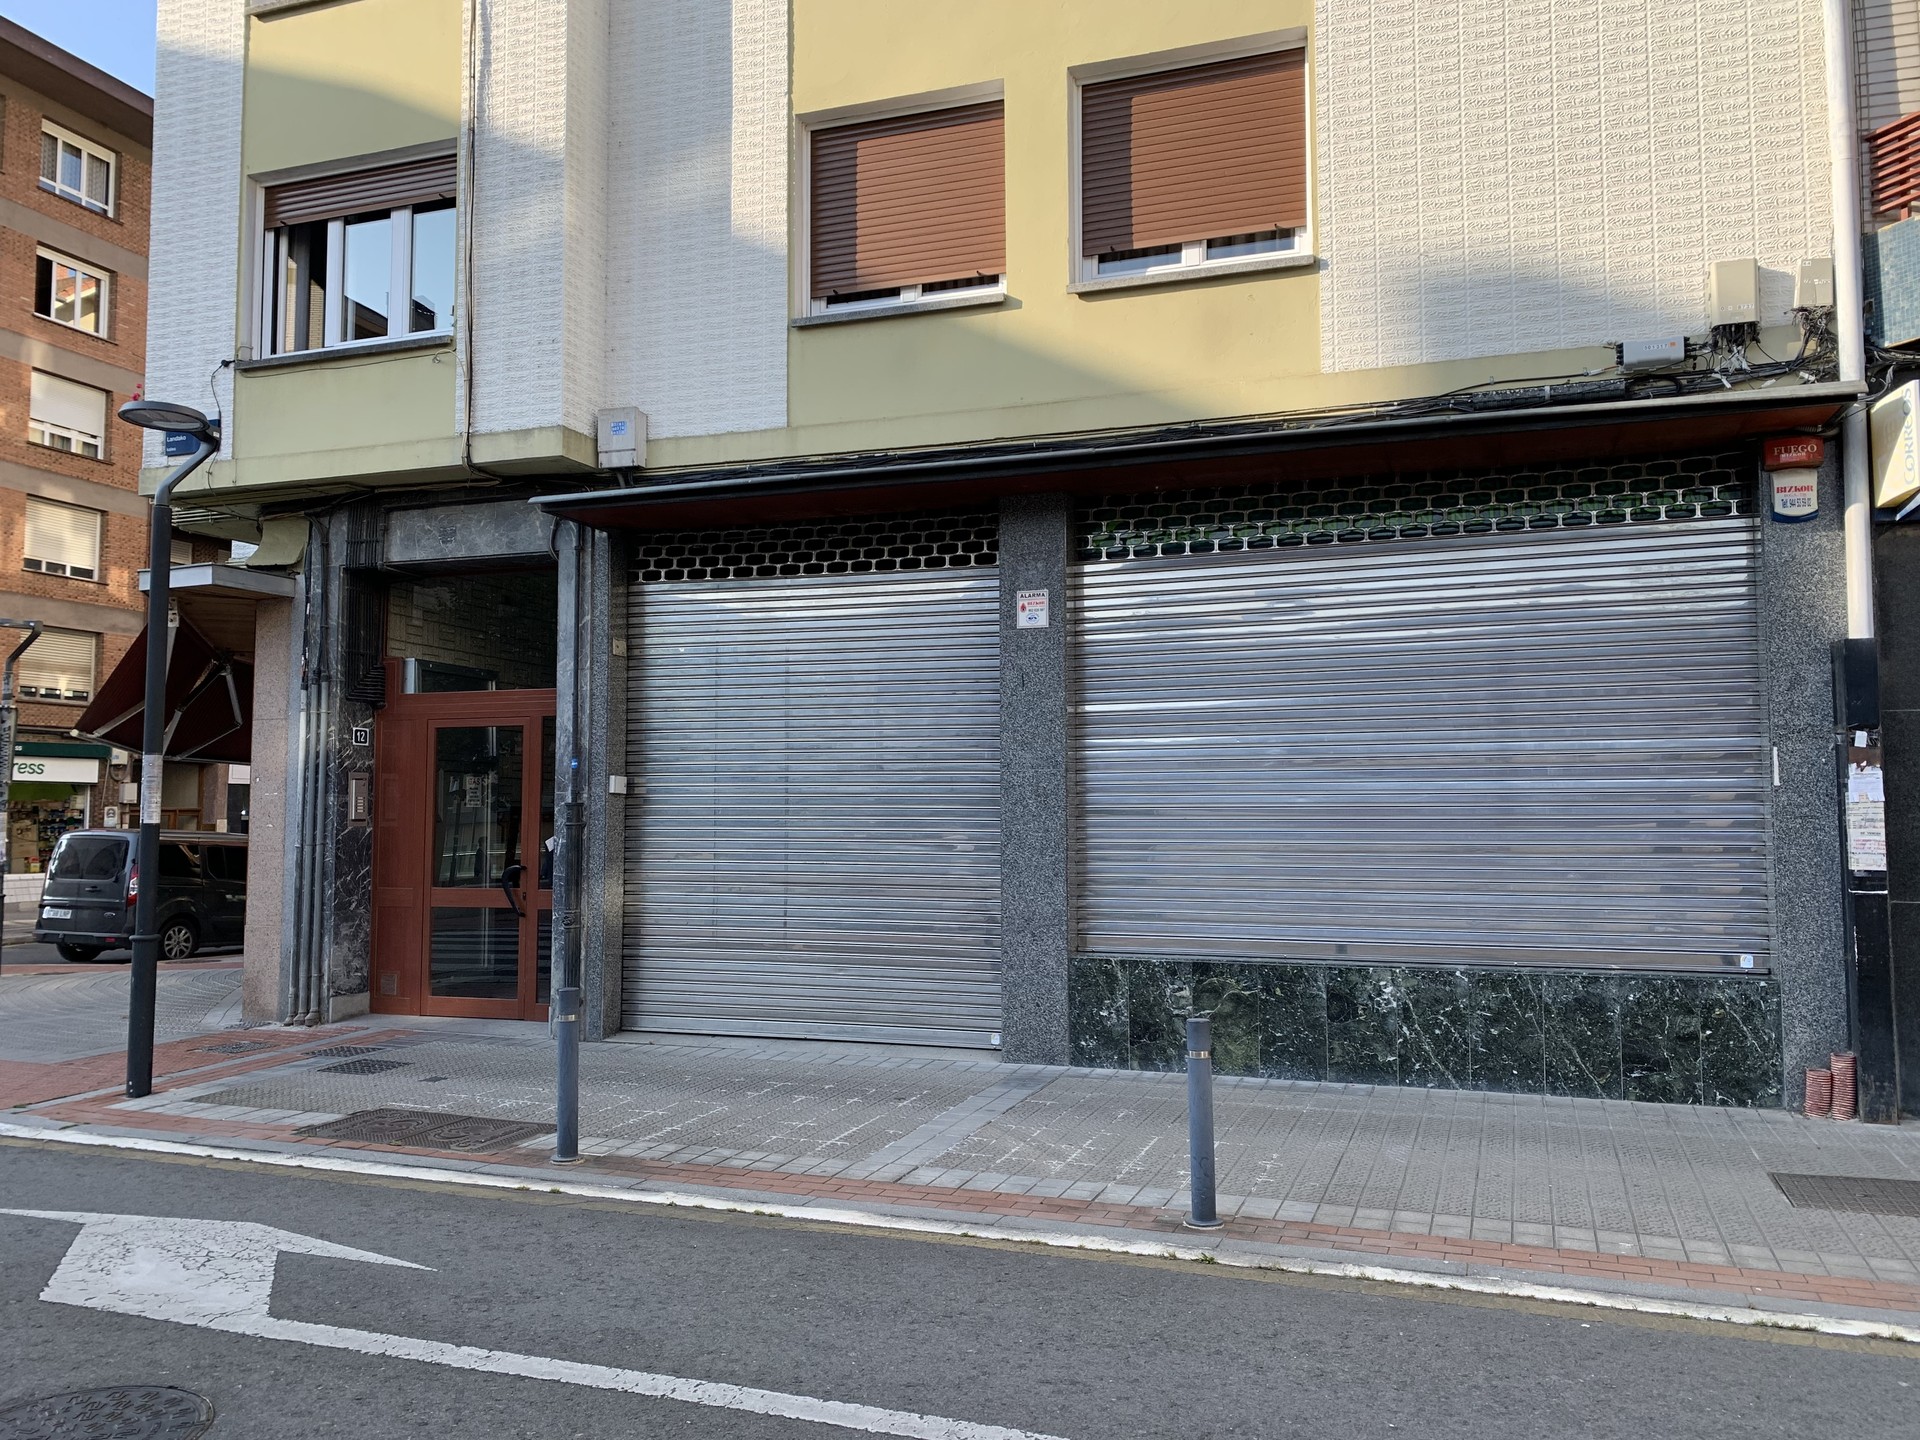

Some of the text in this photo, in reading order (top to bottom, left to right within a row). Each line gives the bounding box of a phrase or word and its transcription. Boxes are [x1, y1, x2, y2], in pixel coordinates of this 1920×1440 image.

[1903, 388, 1916, 485] CORREOS
[1773, 443, 1817, 457] FUEGO
[1776, 485, 1813, 493] BIZKOR
[356, 731, 366, 742] 12
